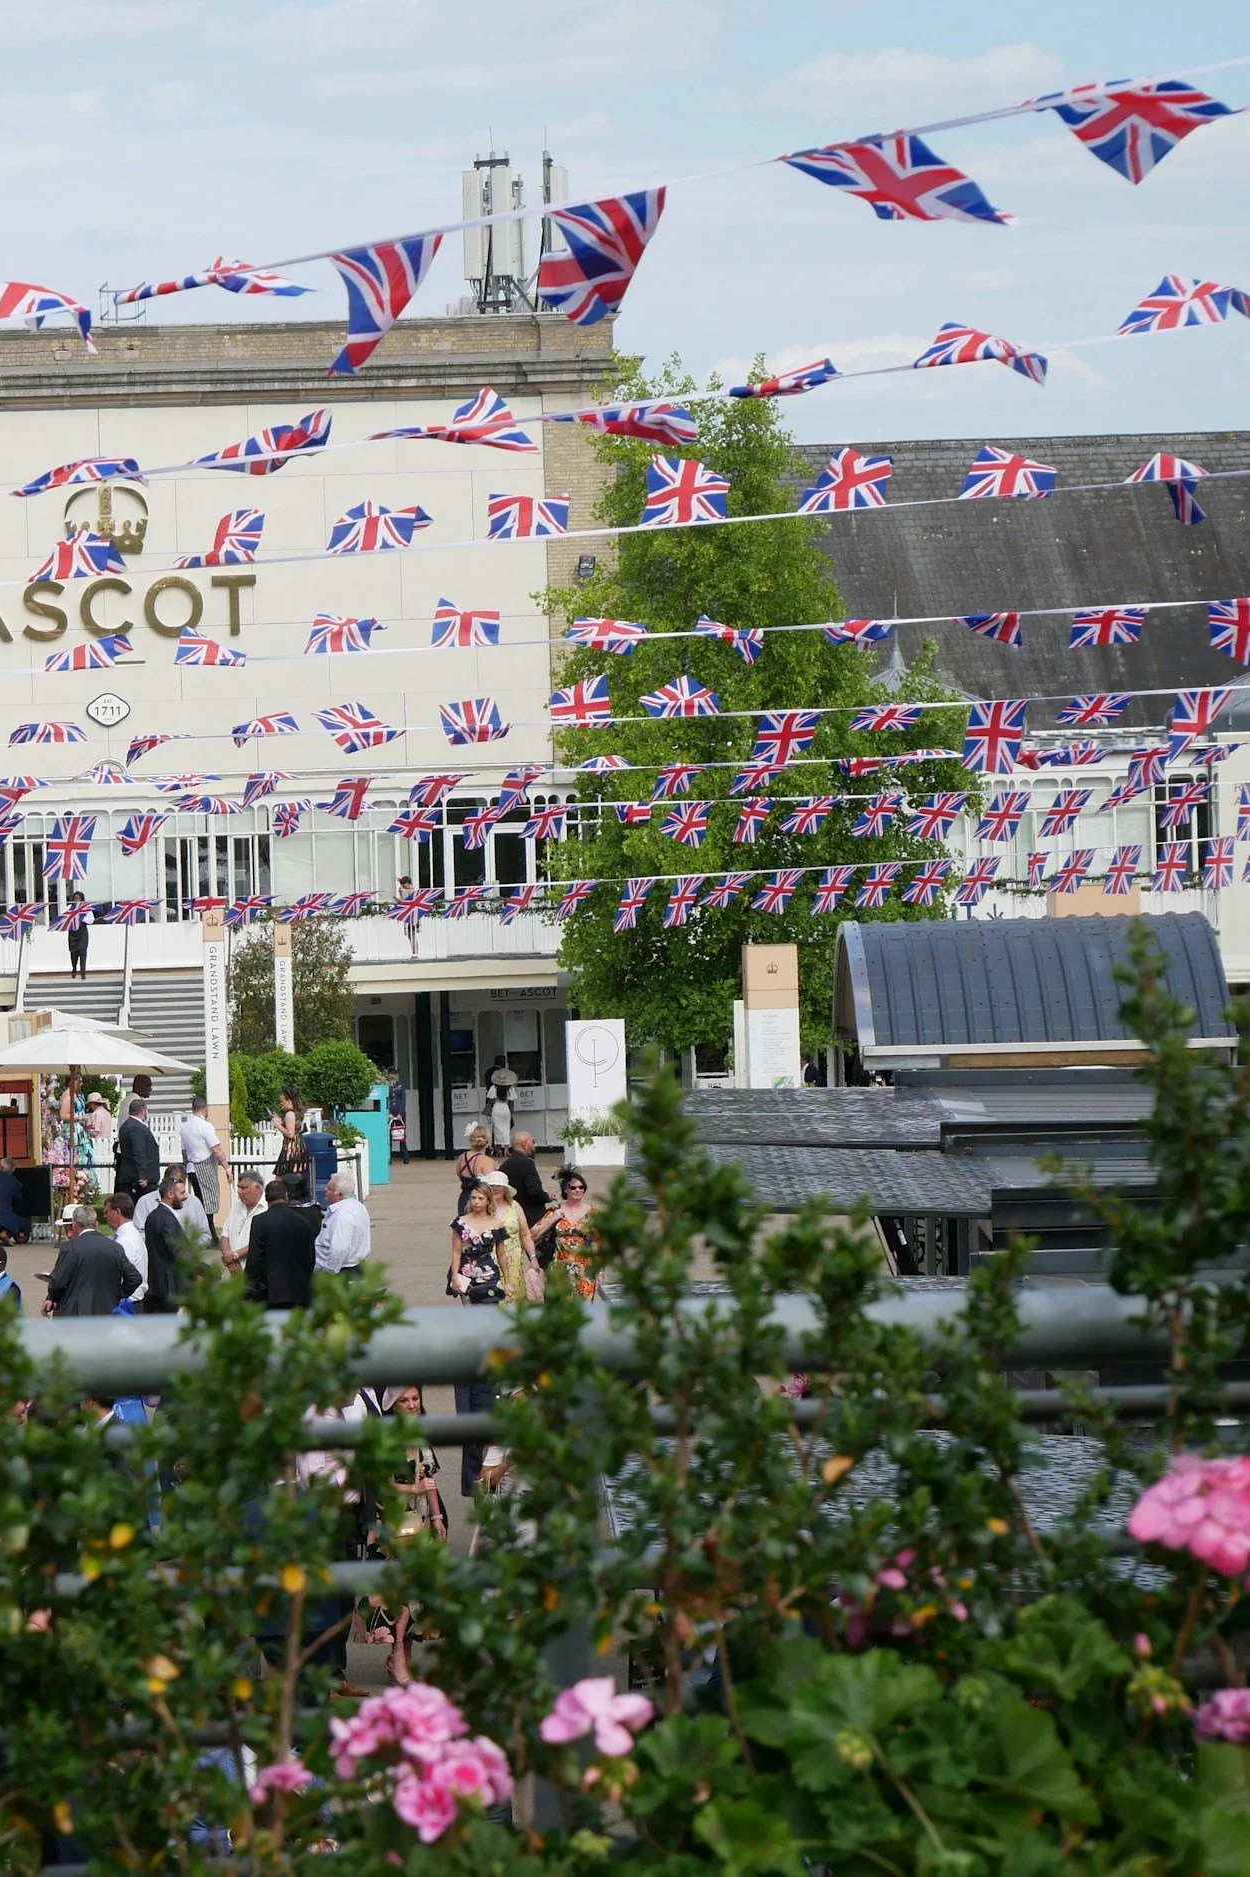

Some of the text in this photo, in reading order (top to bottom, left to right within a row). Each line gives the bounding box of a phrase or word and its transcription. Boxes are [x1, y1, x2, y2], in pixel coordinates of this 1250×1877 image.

[94, 706, 121, 716] 1711
[209, 946, 220, 1059] GRANDSTAND LAWN
[279, 960, 288, 1020] GRANDSTAND
[490, 986, 558, 998] BET ASCOT
